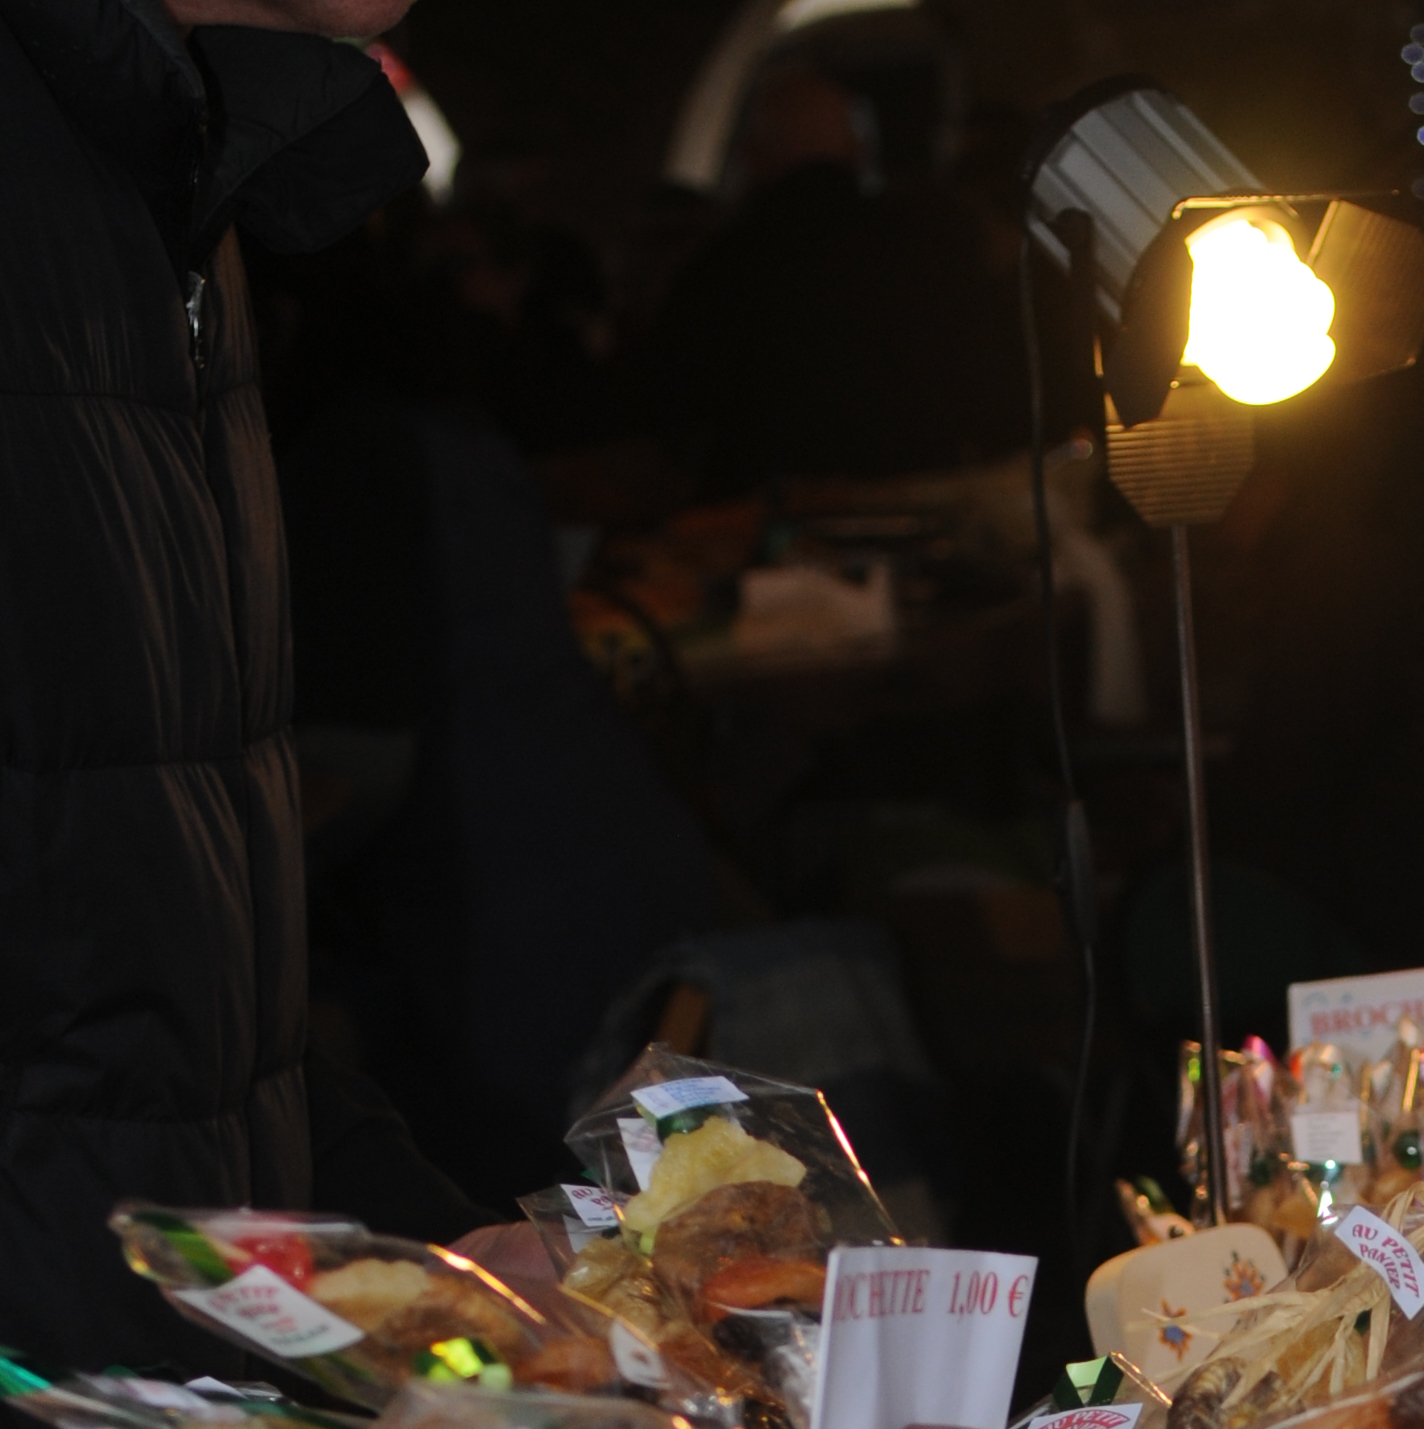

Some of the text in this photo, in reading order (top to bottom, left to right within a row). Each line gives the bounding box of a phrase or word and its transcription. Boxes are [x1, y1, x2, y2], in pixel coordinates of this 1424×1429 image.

[1352, 1223, 1420, 1298] AU PETIT
[1359, 1243, 1401, 1290] PANIER
[949, 1271, 998, 1323] 1,00
[1009, 1274, 1029, 1317] €
[1072, 1409, 1129, 1425] PETIT
